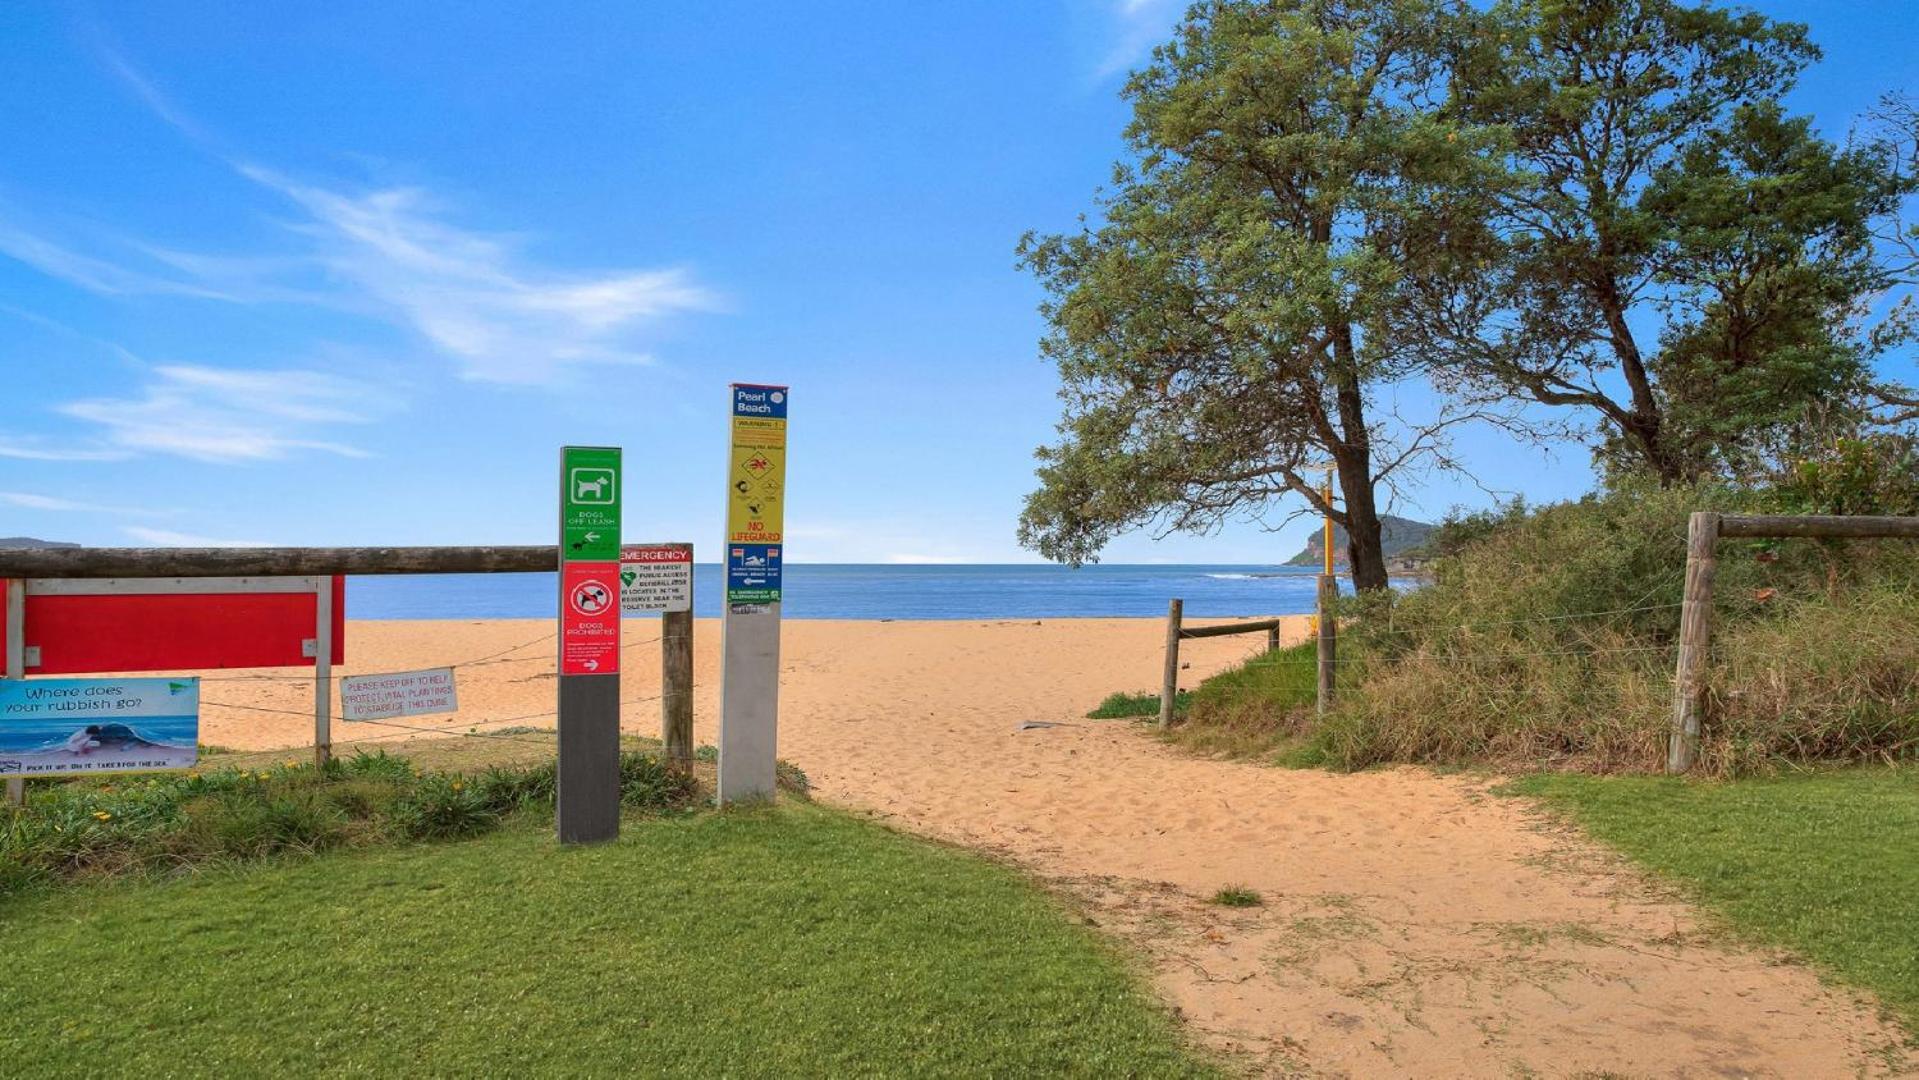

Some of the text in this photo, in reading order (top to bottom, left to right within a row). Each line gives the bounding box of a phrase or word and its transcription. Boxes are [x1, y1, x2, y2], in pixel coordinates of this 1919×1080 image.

[738, 391, 766, 401] Pearl
[738, 403, 771, 413] Beach
[747, 521, 764, 531] NO
[731, 531, 780, 541] LIFEGUARD
[620, 551, 687, 560] EMERGENCY
[347, 675, 448, 692] PLEASE KEEP OFF TO HELP
[25, 685, 123, 700] Where does
[5, 697, 143, 714] your rubbish go?
